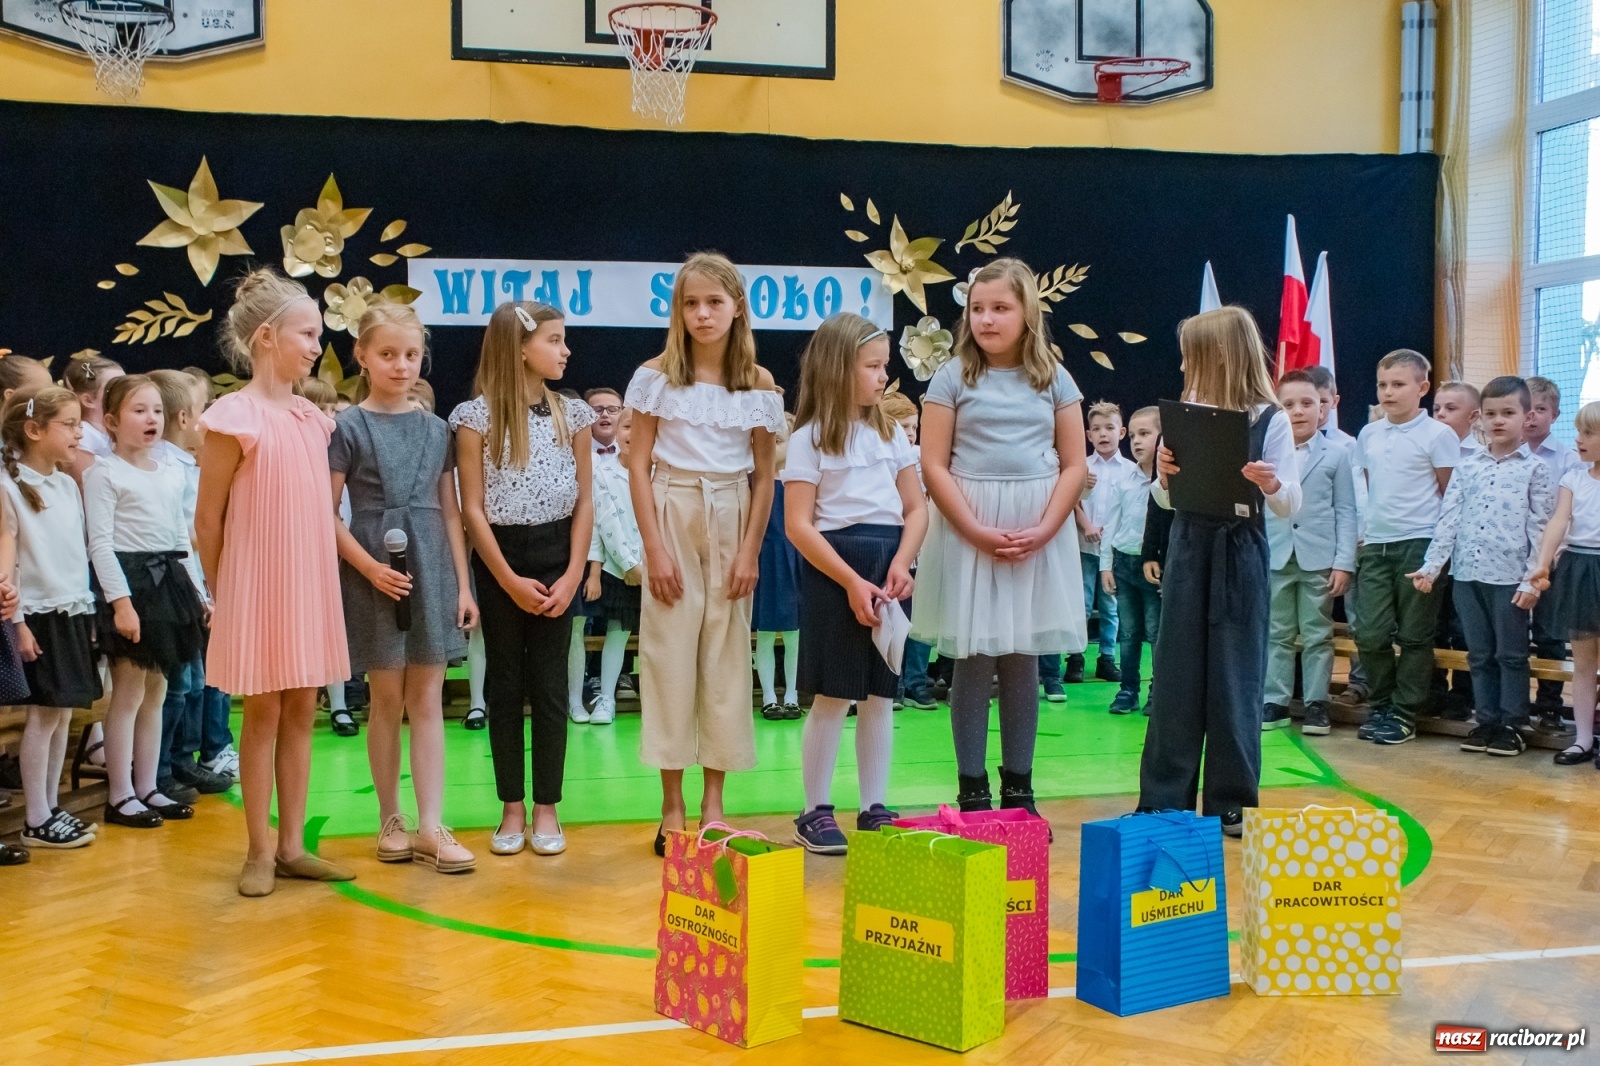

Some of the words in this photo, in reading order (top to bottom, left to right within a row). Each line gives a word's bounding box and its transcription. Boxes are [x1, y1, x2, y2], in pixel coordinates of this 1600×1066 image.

[433, 268, 593, 315] WITAJ
[650, 272, 843, 320] SOŁO
[1313, 881, 1342, 892] DAR
[1006, 897, 1032, 912] ŚCI
[1275, 893, 1384, 908] PRACOWITOŚCI
[694, 904, 715, 922] DAR
[1141, 900, 1204, 923] UŚMIECHU
[667, 913, 738, 949] OSTROŻNOŚCI
[890, 916, 919, 934] DAR
[865, 929, 942, 957] PRZYJAŹNI
